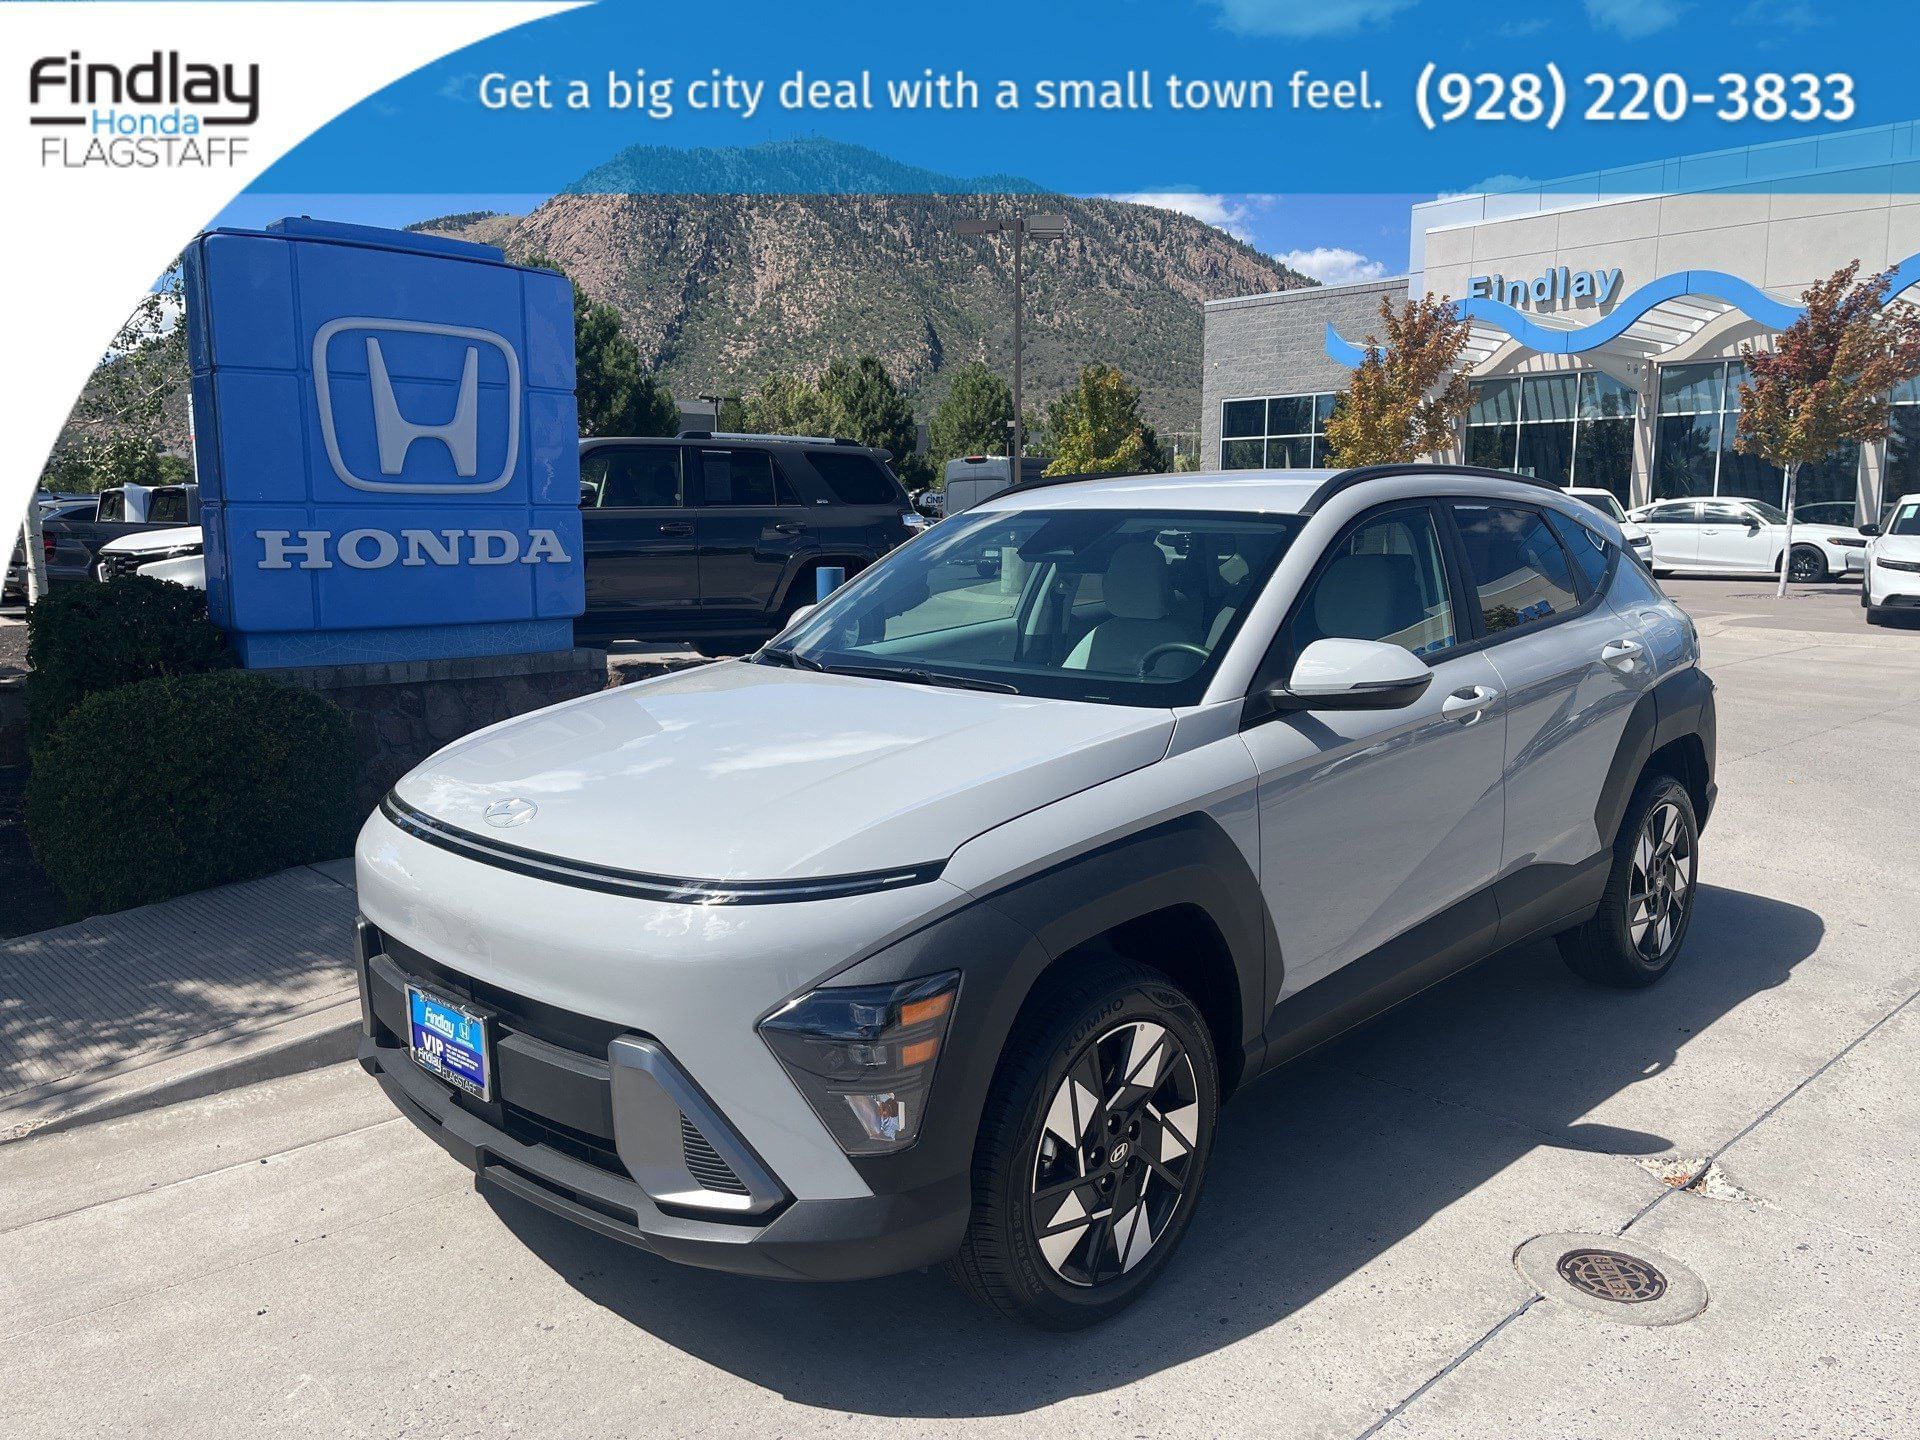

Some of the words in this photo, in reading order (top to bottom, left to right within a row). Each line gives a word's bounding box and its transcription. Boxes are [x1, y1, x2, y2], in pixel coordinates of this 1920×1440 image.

[1467, 266, 1622, 304] Findlay
[255, 528, 571, 570] HONDA
[425, 1008, 454, 1038] Findlay
[422, 1031, 444, 1056] VIP
[441, 1067, 477, 1093] FLAGSTAFF
